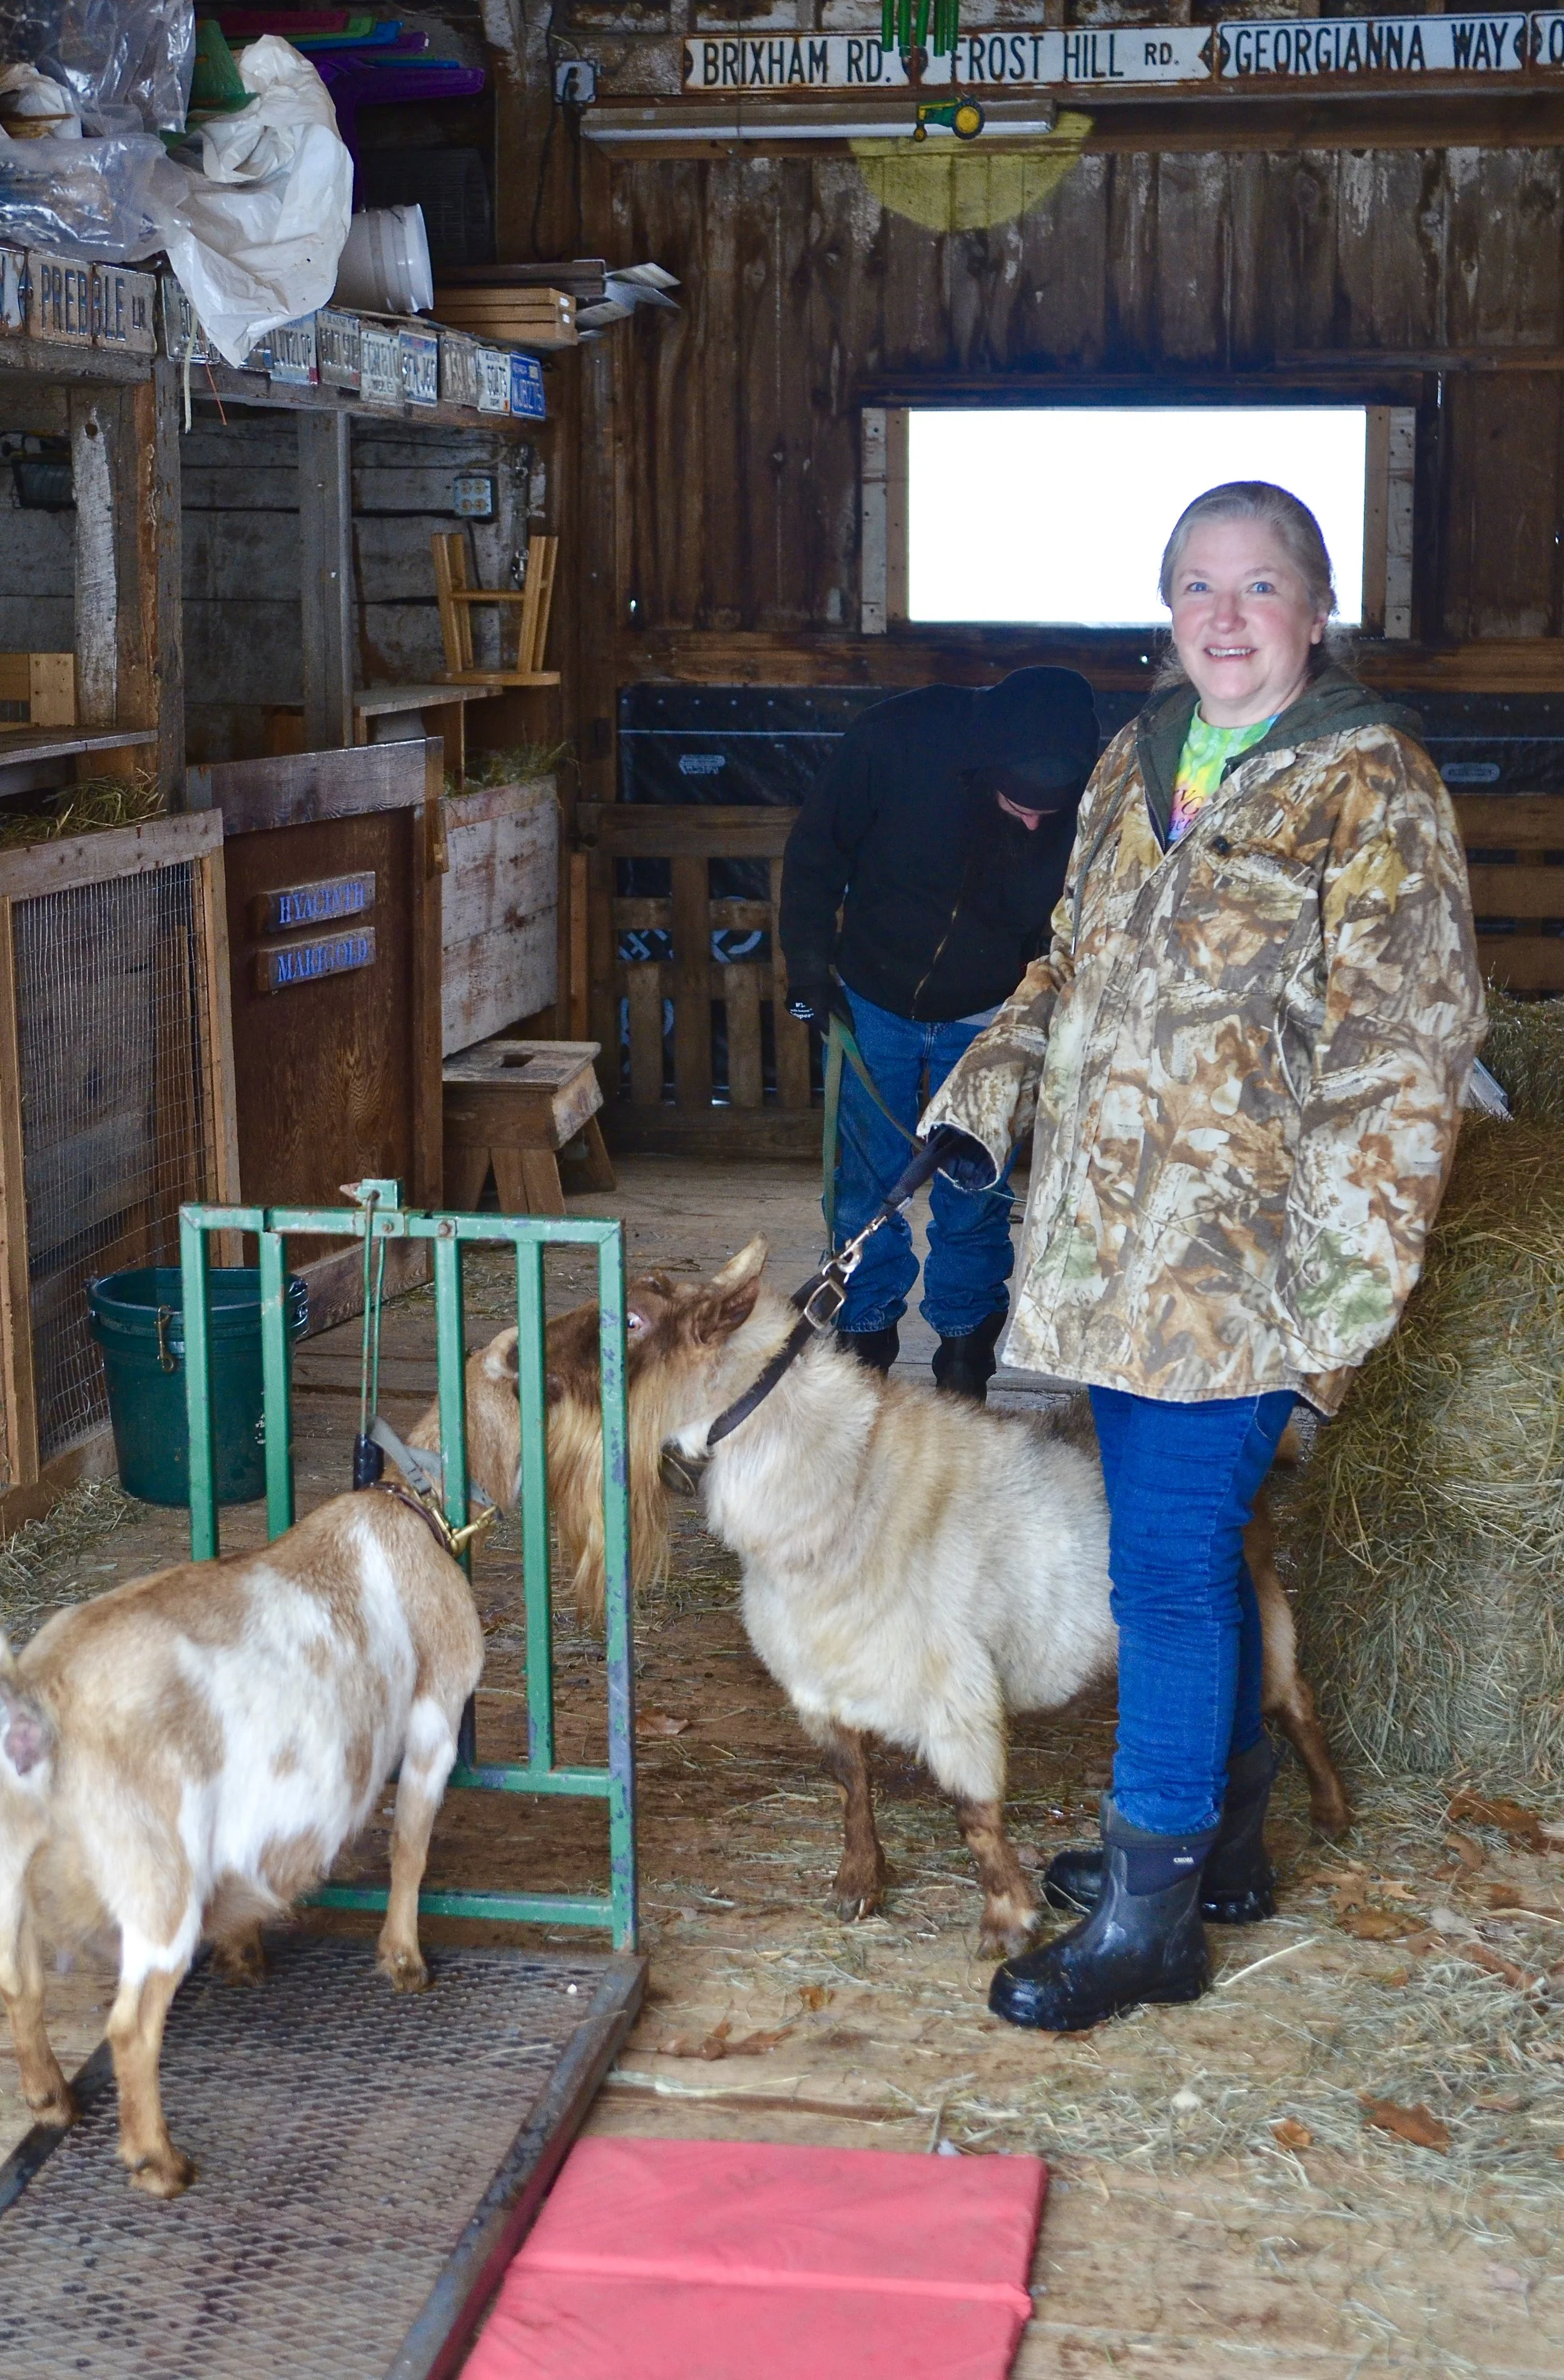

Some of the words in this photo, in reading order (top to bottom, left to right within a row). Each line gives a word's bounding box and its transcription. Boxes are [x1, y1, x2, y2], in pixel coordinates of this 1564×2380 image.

[703, 39, 828, 85] BRIXHAM
[847, 38, 891, 83] RD.
[1064, 30, 1124, 80] HILL
[1144, 41, 1180, 67] RD.
[1235, 25, 1425, 74] GEORGIANNA
[1451, 22, 1509, 69] WAY
[279, 881, 365, 924] HYACINTH
[277, 937, 368, 983] MARIGOLD
